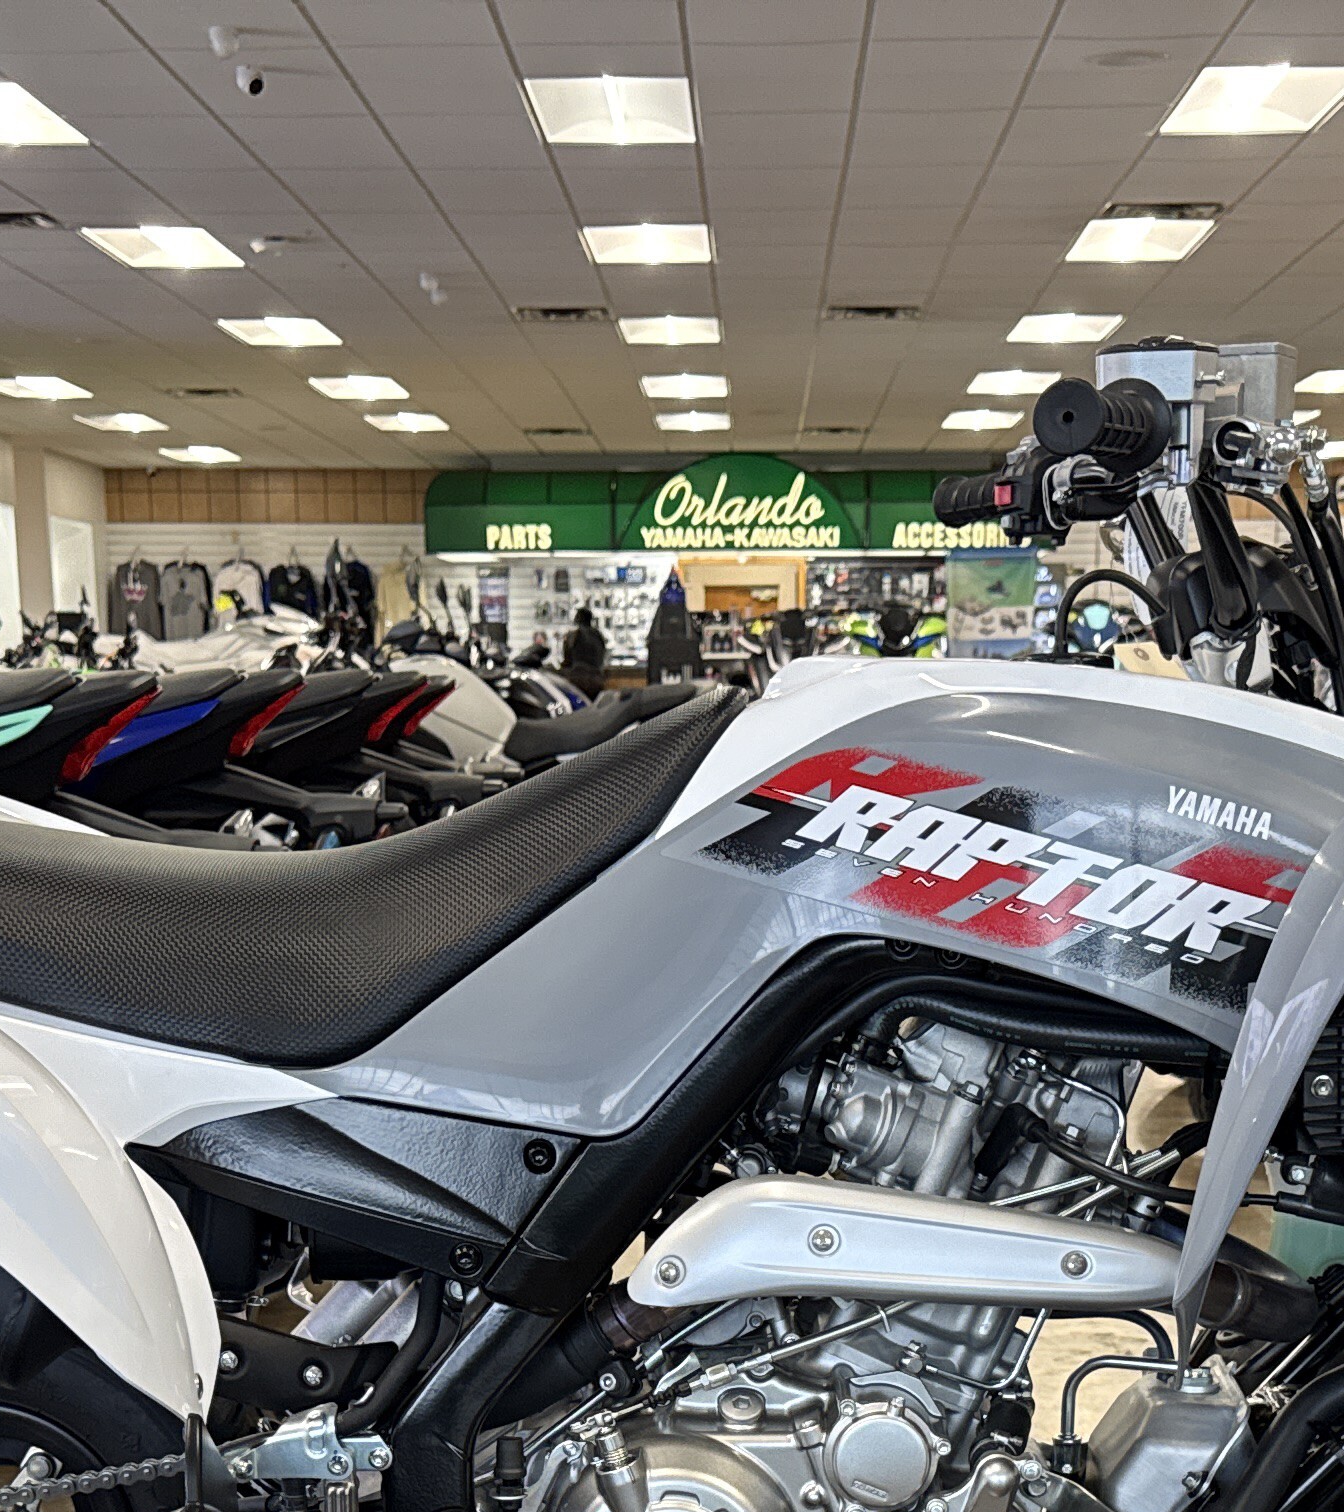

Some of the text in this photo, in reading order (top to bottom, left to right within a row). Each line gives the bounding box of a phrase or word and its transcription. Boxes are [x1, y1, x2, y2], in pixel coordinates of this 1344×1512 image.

[653, 472, 825, 526] Orlando
[486, 524, 552, 551] PARTS
[640, 526, 841, 549] YAMAHA-KAWASAKI
[892, 522, 1031, 549] ACCESSOR
[1166, 785, 1273, 841] YAMAHA
[761, 784, 1278, 953] RAPTOR
[781, 838, 1205, 965] SEVEN HUNDRED
